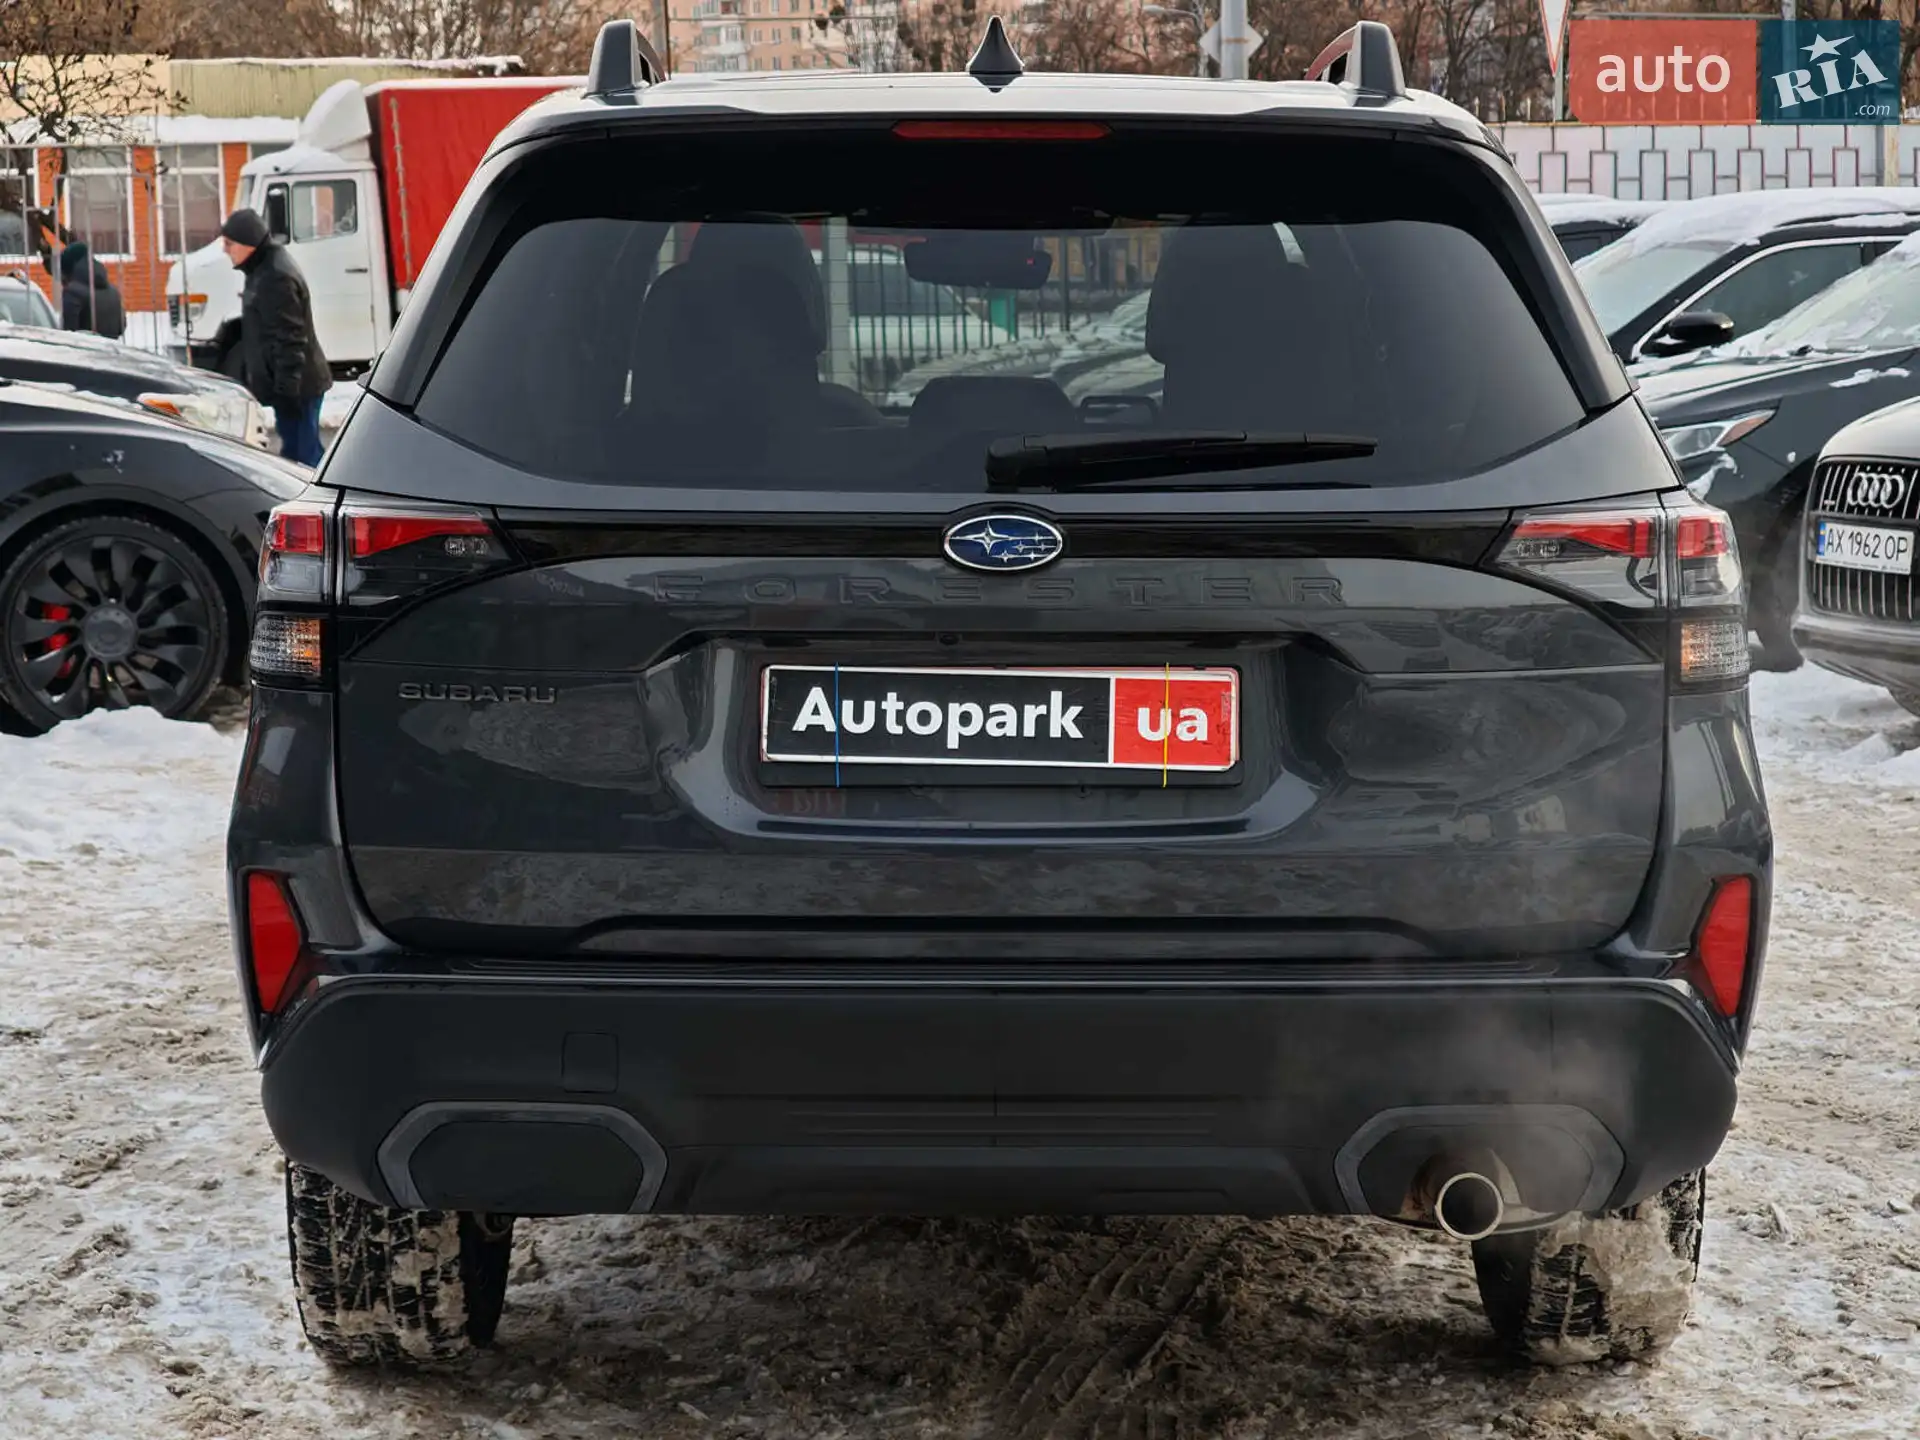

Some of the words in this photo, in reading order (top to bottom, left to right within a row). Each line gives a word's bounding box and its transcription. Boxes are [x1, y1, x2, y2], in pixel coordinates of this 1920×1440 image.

[1826, 528, 1845, 554] AX
[1848, 530, 1881, 559] 1962
[1884, 535, 1908, 561] OP
[652, 574, 1346, 606] FORESTER
[397, 682, 557, 704] SUBARU
[791, 686, 1085, 750] Autopark
[1137, 706, 1209, 742] ua
